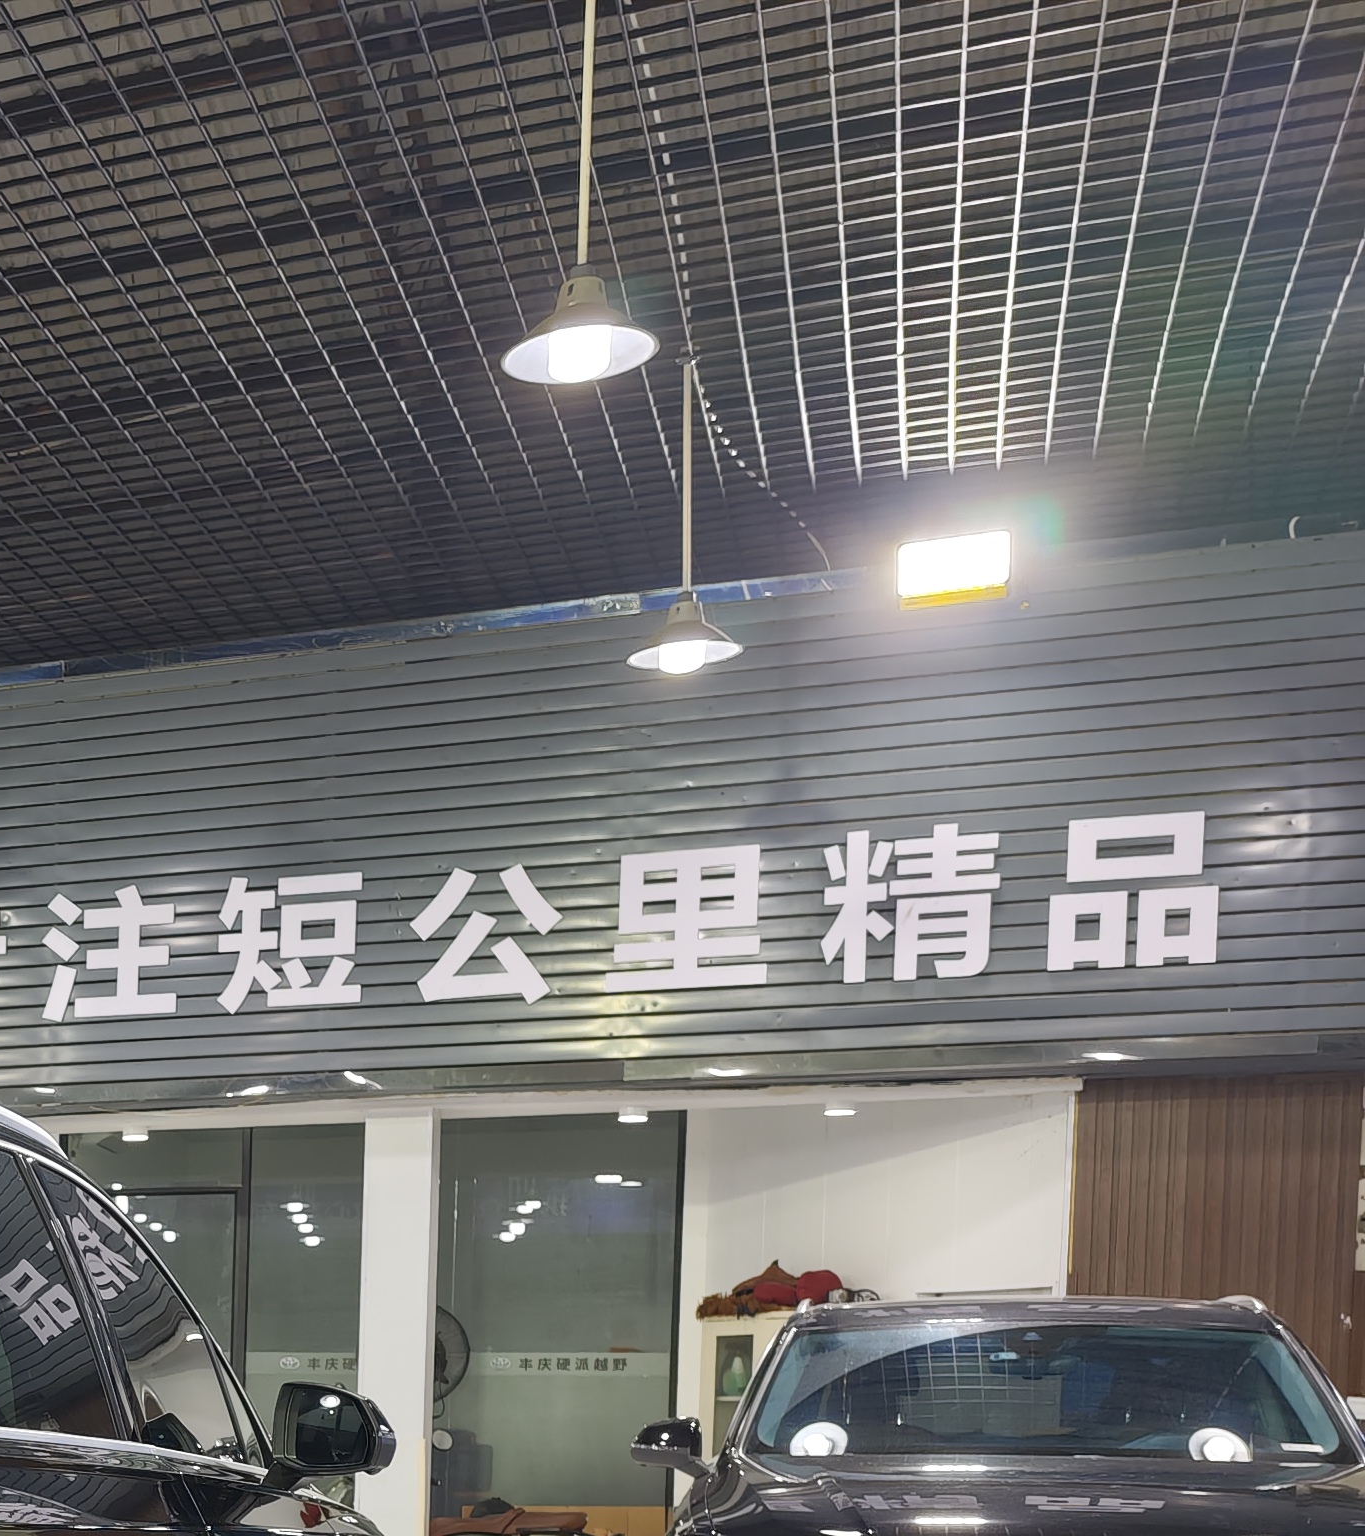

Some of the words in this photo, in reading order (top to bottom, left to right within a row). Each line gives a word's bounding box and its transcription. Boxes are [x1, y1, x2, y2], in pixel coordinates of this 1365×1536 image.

[518, 1357, 628, 1372] 丰庆硬派越野
